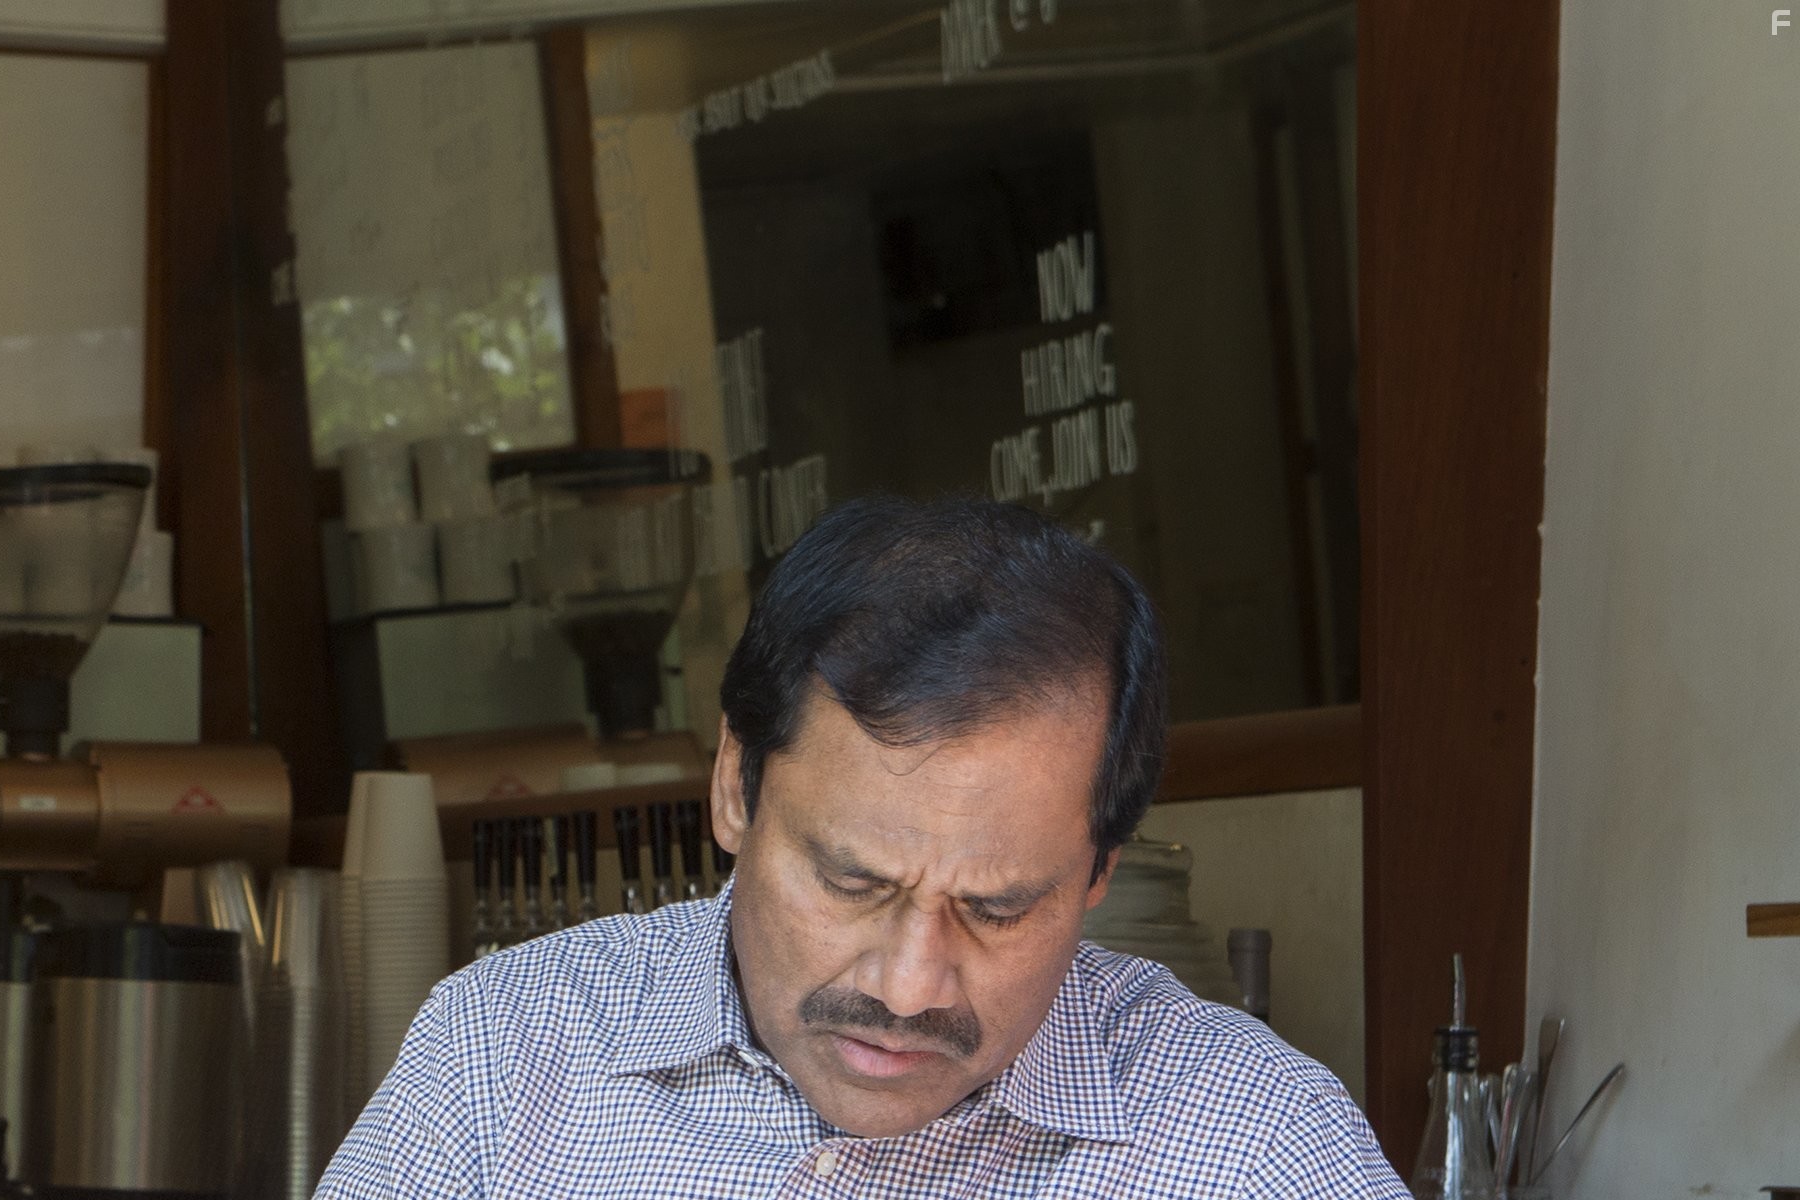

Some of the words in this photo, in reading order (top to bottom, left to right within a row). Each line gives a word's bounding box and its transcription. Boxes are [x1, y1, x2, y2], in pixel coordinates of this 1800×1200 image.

[1036, 231, 1094, 323] NOW
[1020, 323, 1117, 418] HIRING
[1047, 405, 1101, 493] JOIN
[1104, 398, 1138, 476] US
